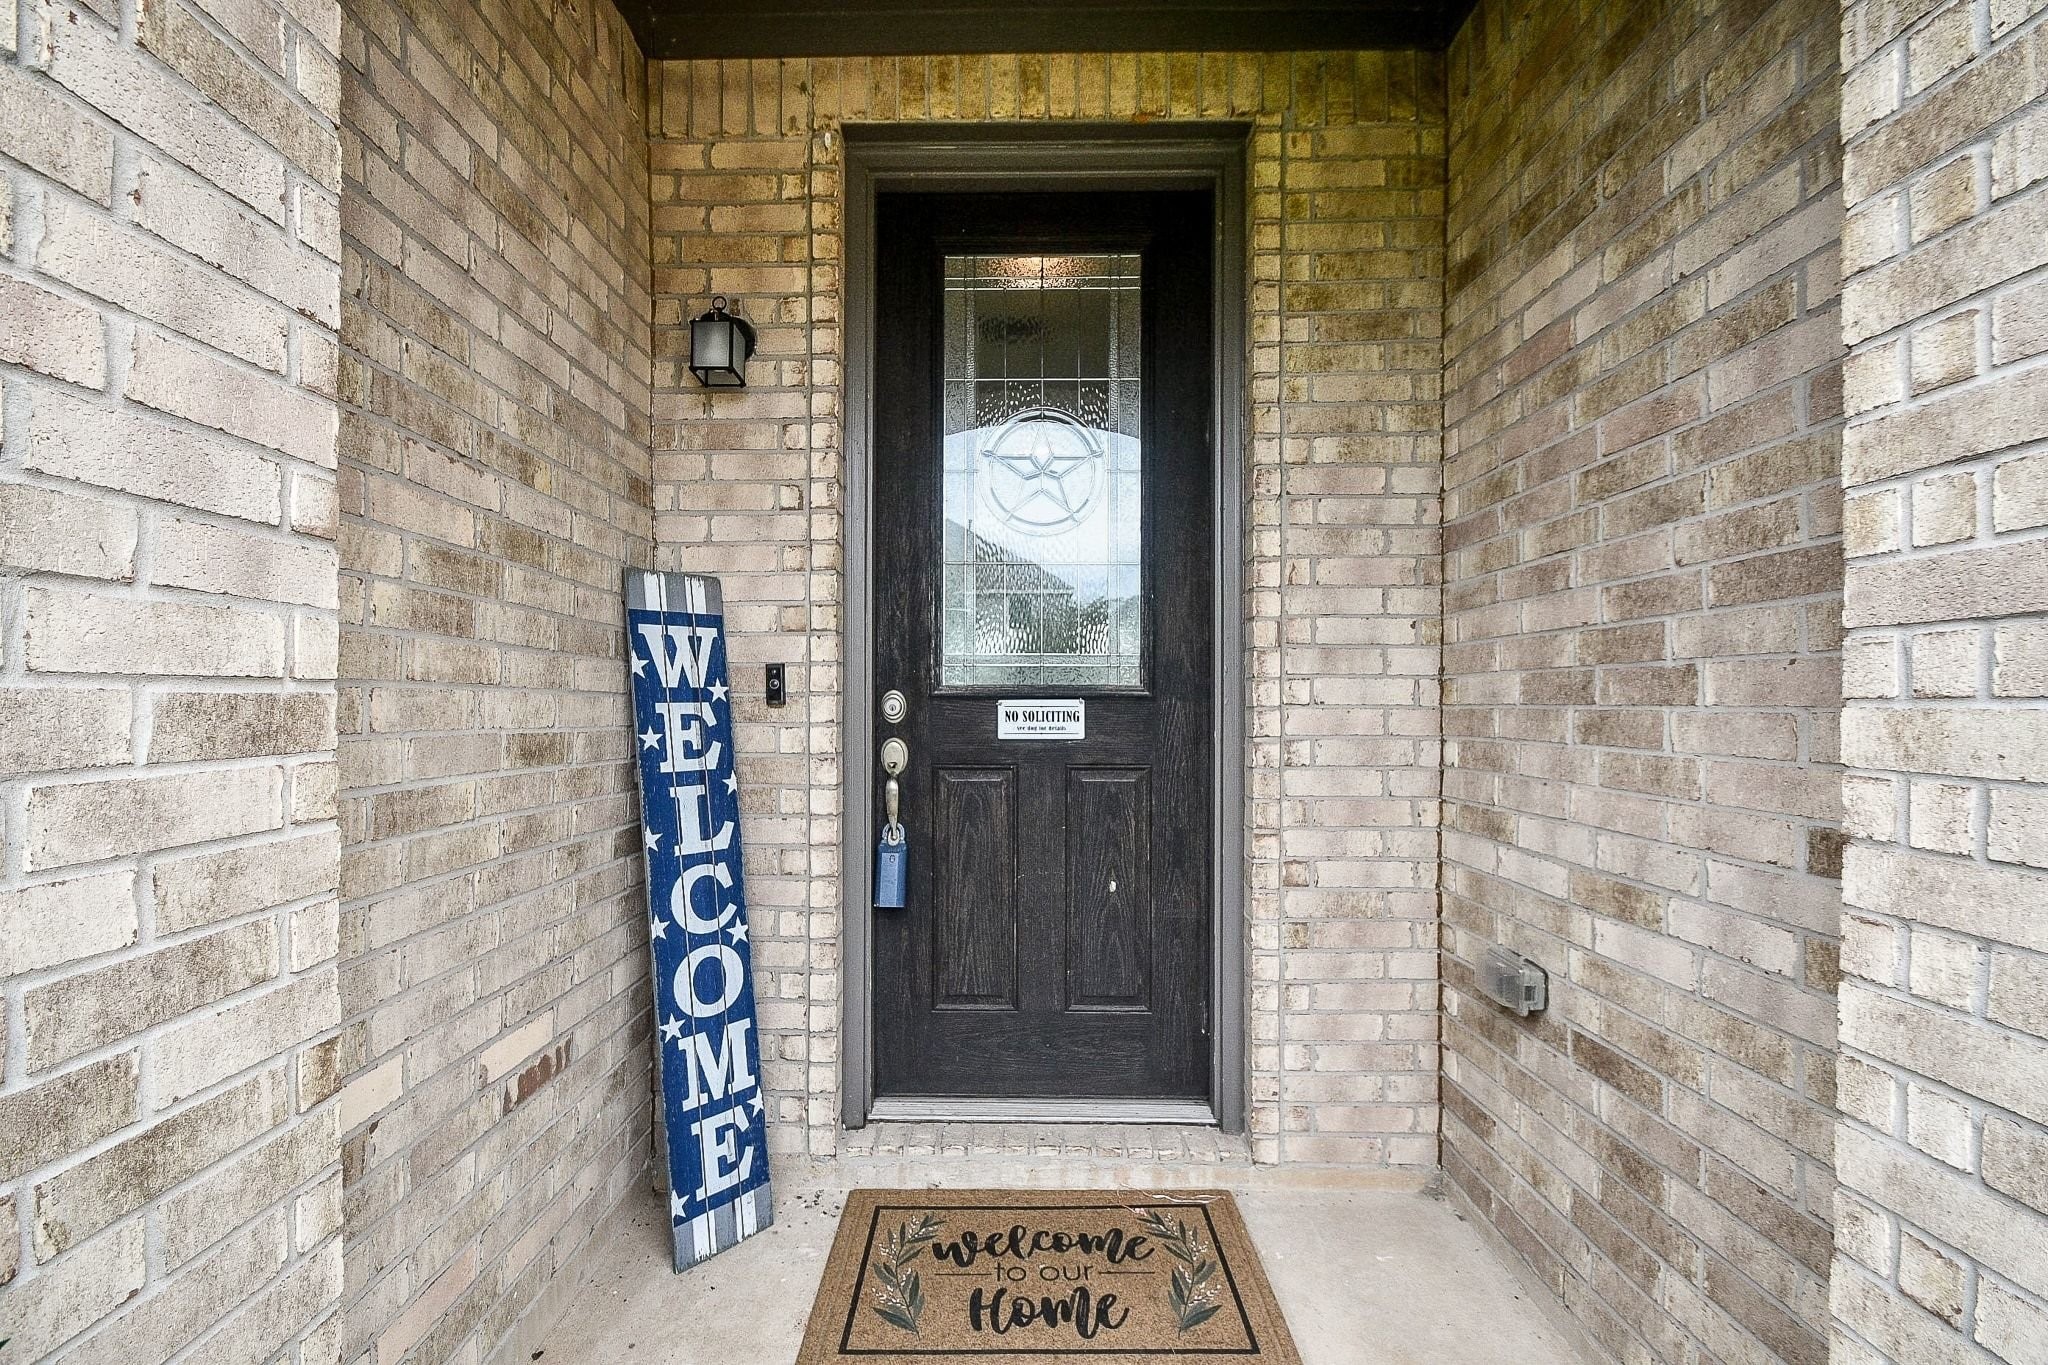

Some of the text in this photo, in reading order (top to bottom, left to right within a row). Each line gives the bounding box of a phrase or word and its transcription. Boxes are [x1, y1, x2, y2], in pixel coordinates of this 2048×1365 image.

[1005, 711, 1079, 722] NO SOLICITING
[638, 623, 756, 1201] WELCOME
[932, 1225, 1155, 1267] welcome
[995, 1262, 1093, 1282] to our
[970, 1286, 1129, 1339] Home
